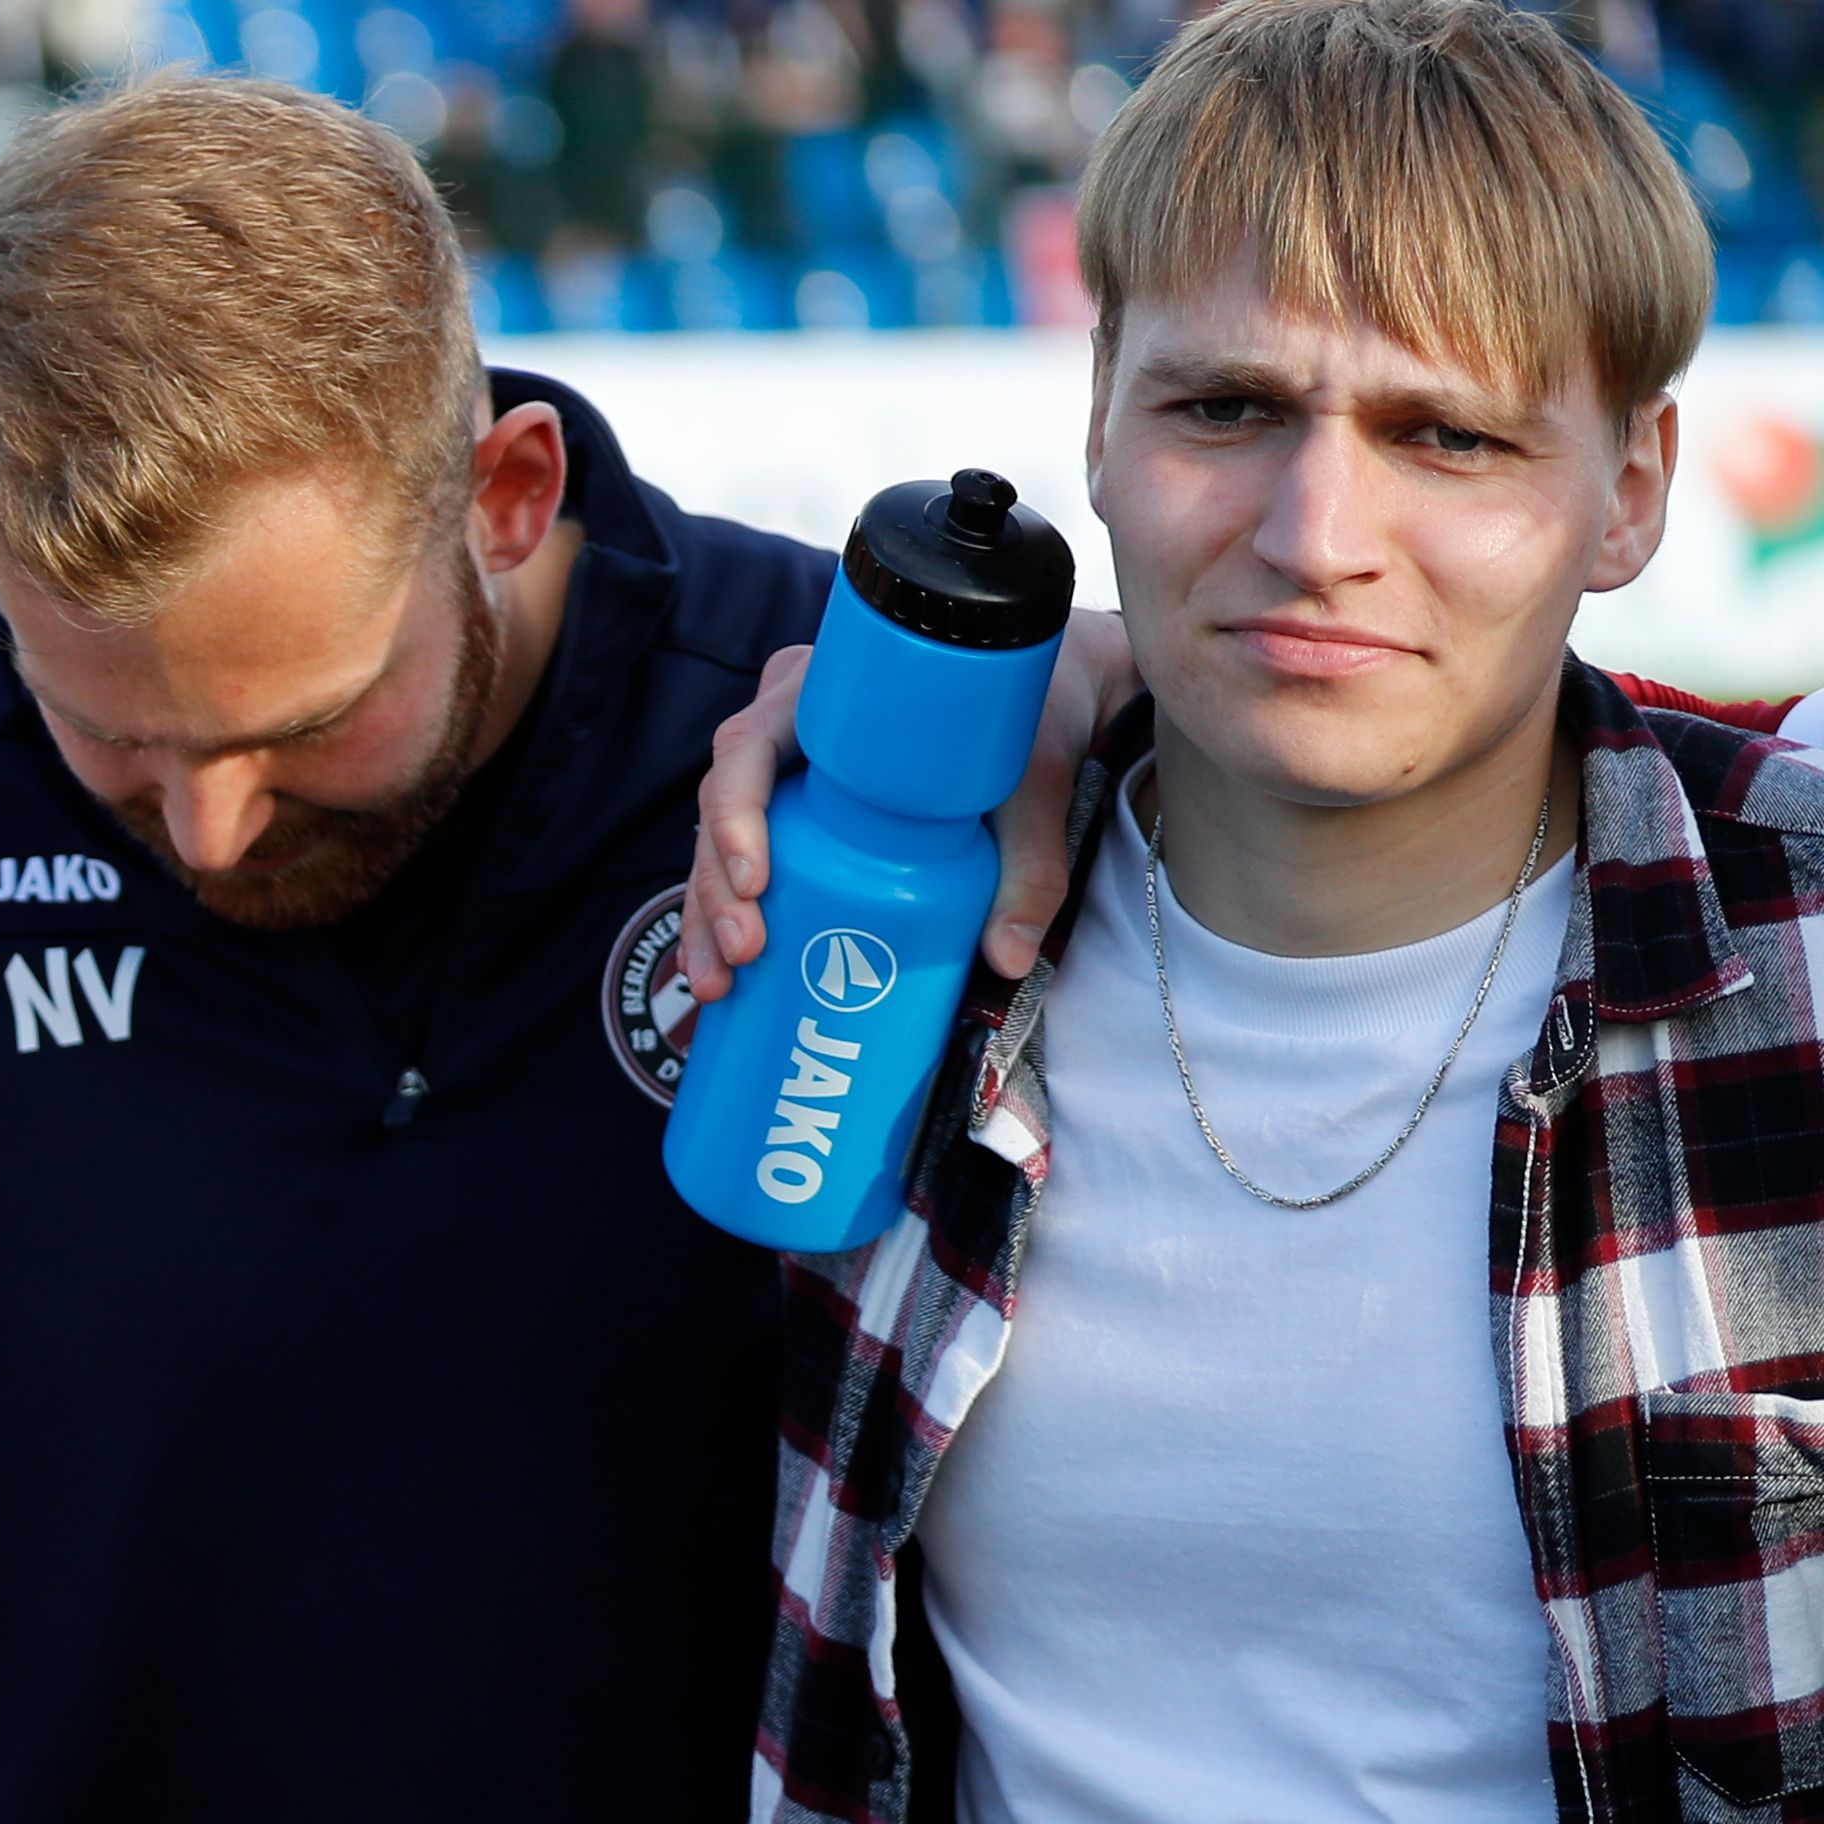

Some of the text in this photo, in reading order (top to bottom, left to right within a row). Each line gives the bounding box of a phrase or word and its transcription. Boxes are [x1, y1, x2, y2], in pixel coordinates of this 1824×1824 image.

[4, 946, 147, 1054] NV
[630, 1028, 657, 1052] 19
[756, 1016, 862, 1205] JAKO
